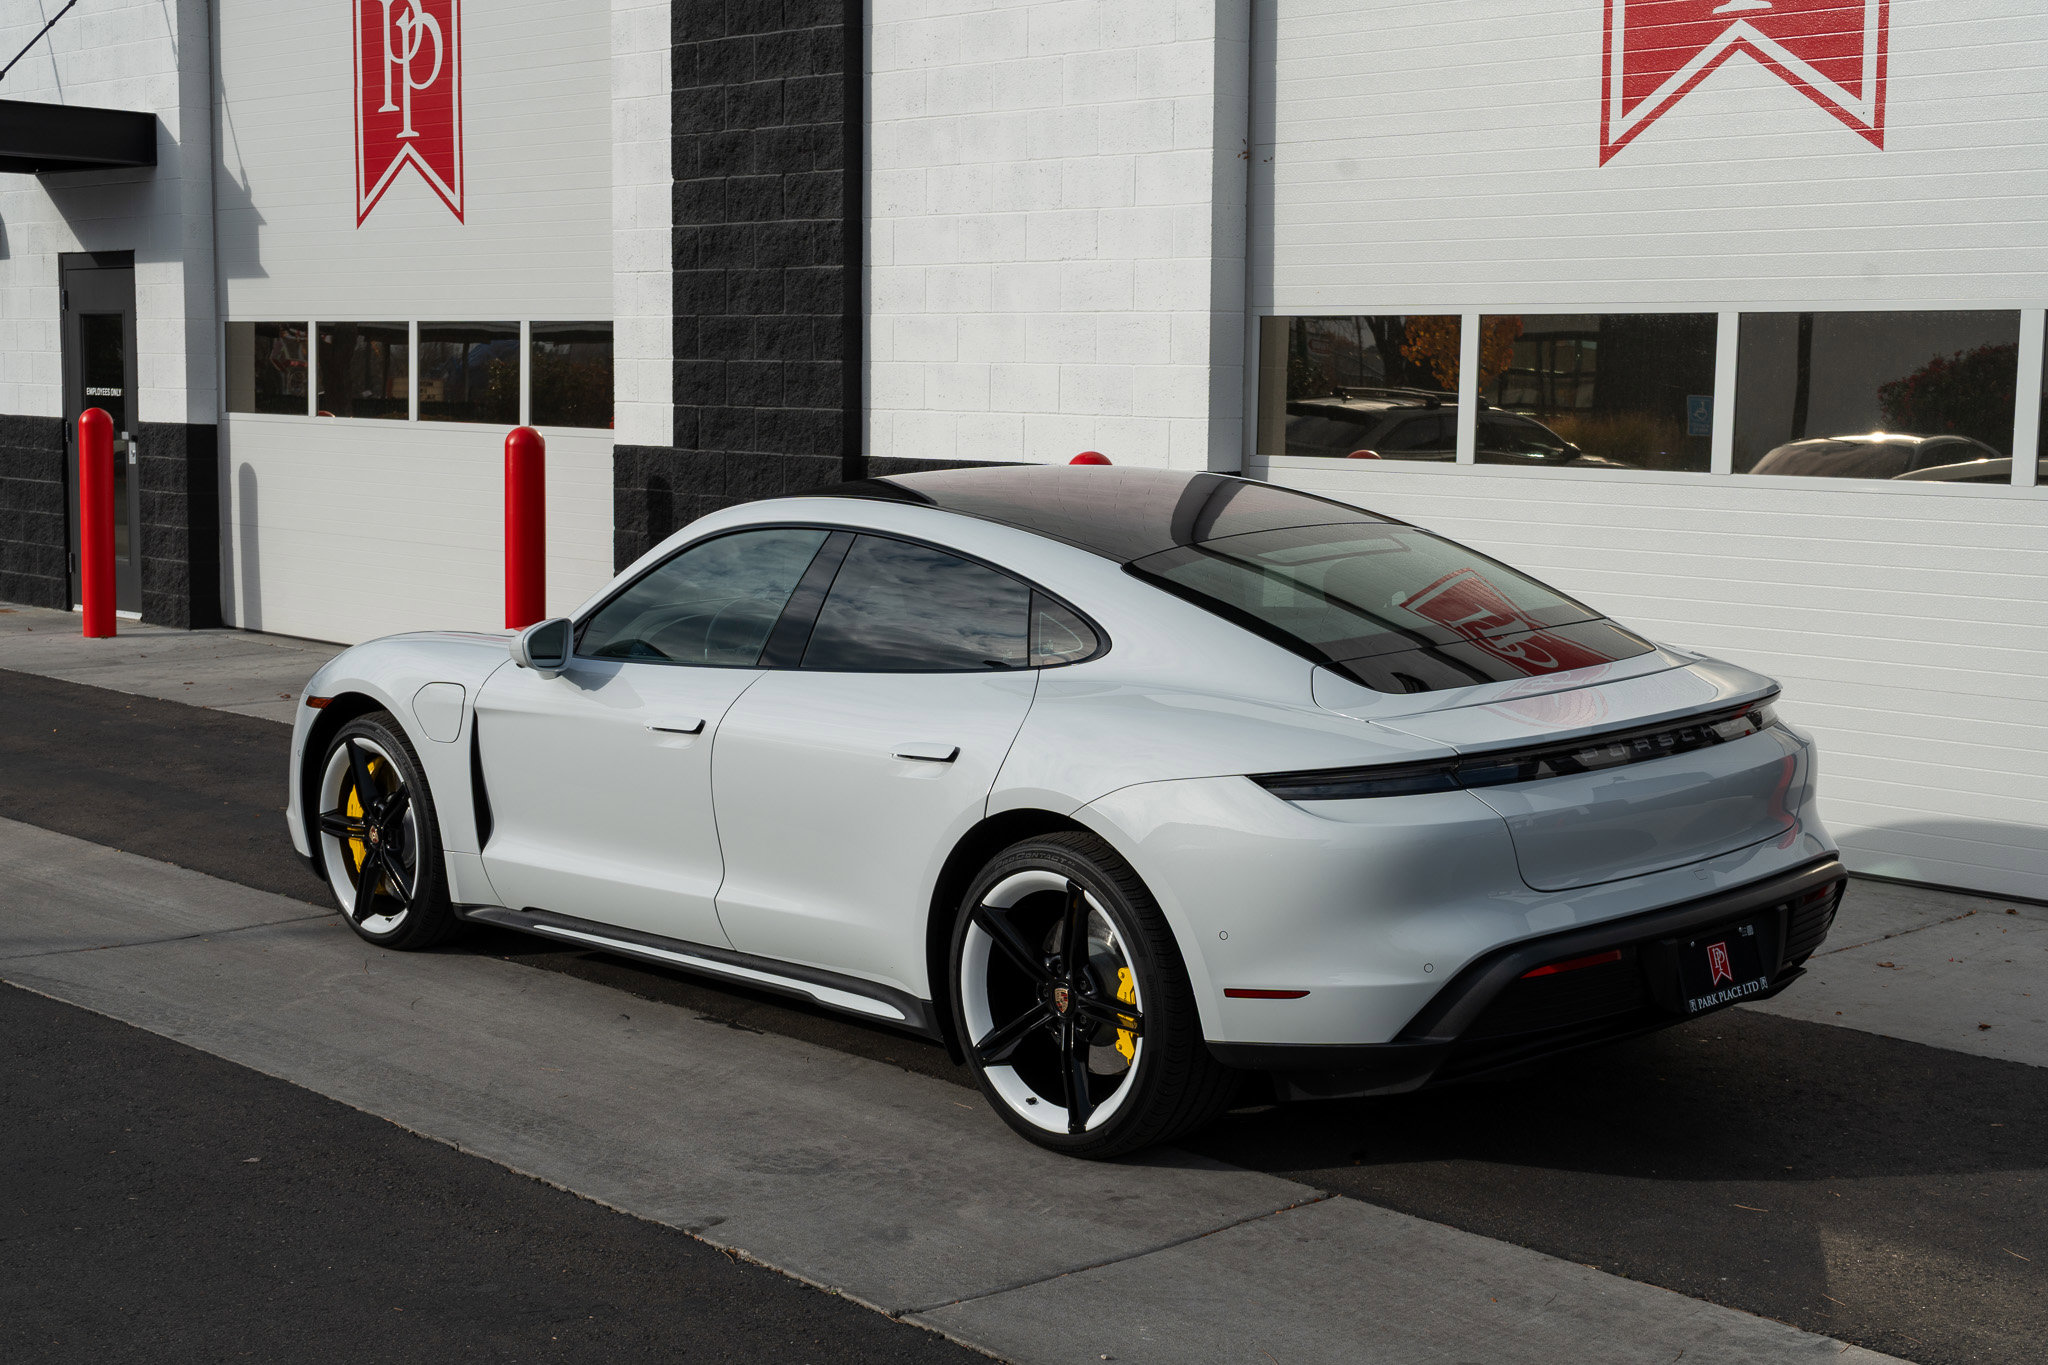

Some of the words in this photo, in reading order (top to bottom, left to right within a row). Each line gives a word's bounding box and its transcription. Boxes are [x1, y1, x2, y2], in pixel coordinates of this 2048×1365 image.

[86, 387, 110, 396] EMPLOYEES
[110, 387, 122, 397] ONLY
[1698, 992, 1719, 1009] PARK
[1719, 986, 1742, 1002] PLACE
[1742, 981, 1759, 995] LTD
